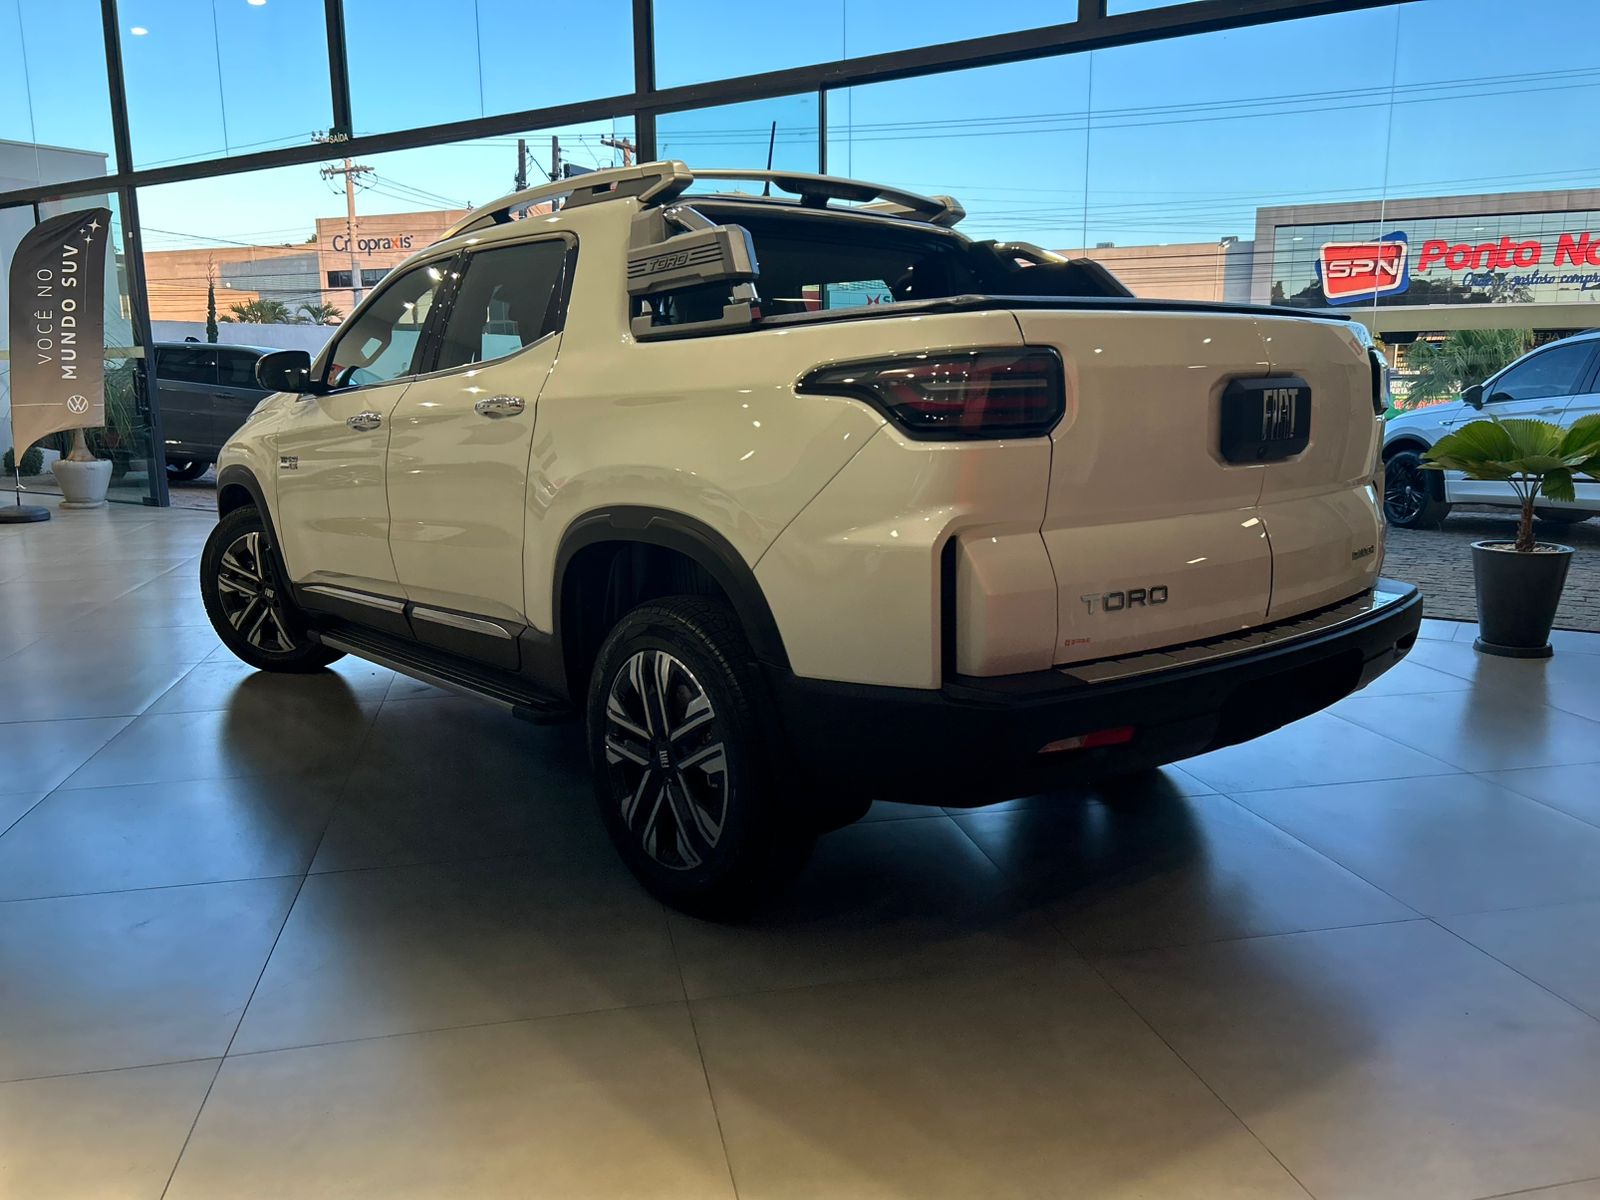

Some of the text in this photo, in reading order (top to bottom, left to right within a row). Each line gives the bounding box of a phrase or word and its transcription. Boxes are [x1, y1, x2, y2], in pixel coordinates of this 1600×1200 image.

[329, 131, 349, 144] SAÍDA
[332, 233, 412, 256] Cropraxis
[1417, 235, 1542, 272] Ponto
[648, 252, 689, 272] TORO
[1327, 257, 1399, 278] SPN
[34, 268, 53, 365] VOCÊ NO
[61, 244, 79, 380] MUNDO SUV
[1261, 388, 1299, 441] FIAT
[1081, 585, 1168, 615] TORO
